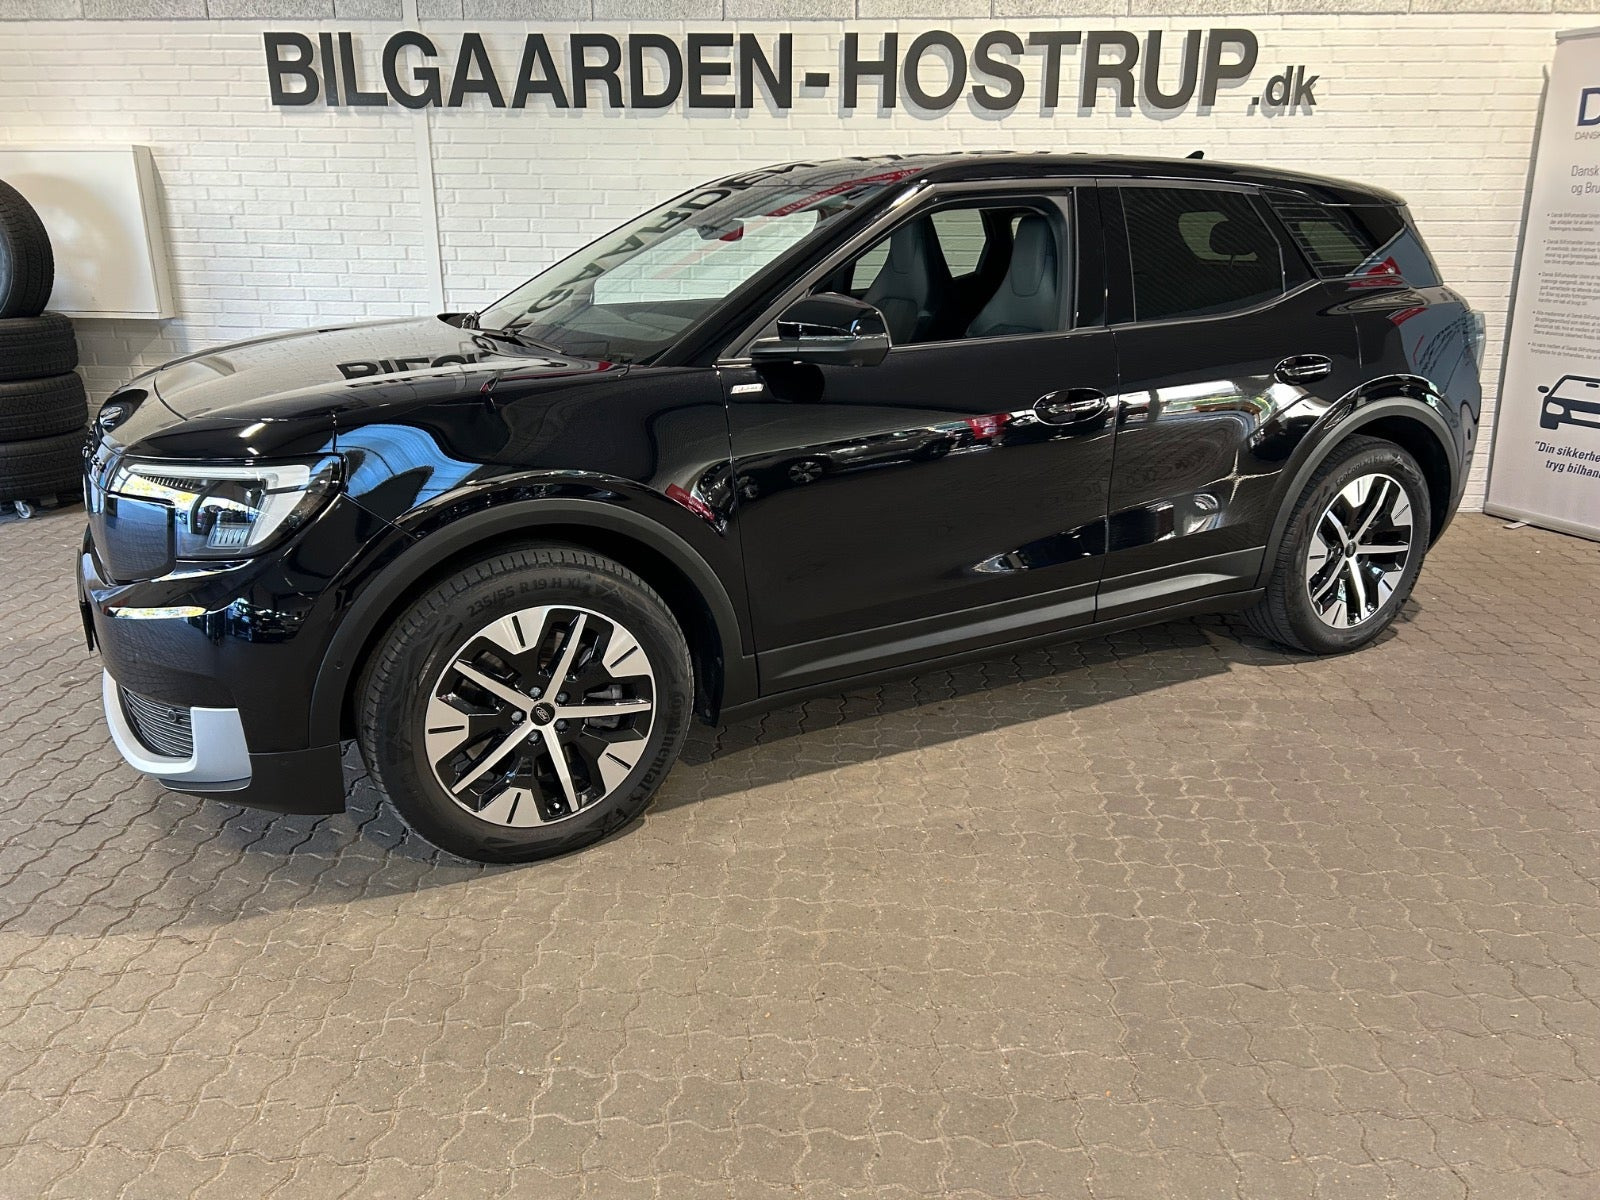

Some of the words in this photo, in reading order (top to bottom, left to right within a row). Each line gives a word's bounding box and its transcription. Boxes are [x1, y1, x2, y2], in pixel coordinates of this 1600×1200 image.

[1571, 165, 1600, 176] Dansk
[1571, 184, 1583, 195] og
[1546, 460, 1565, 473] tryg
[1567, 462, 1600, 478] bilhan
